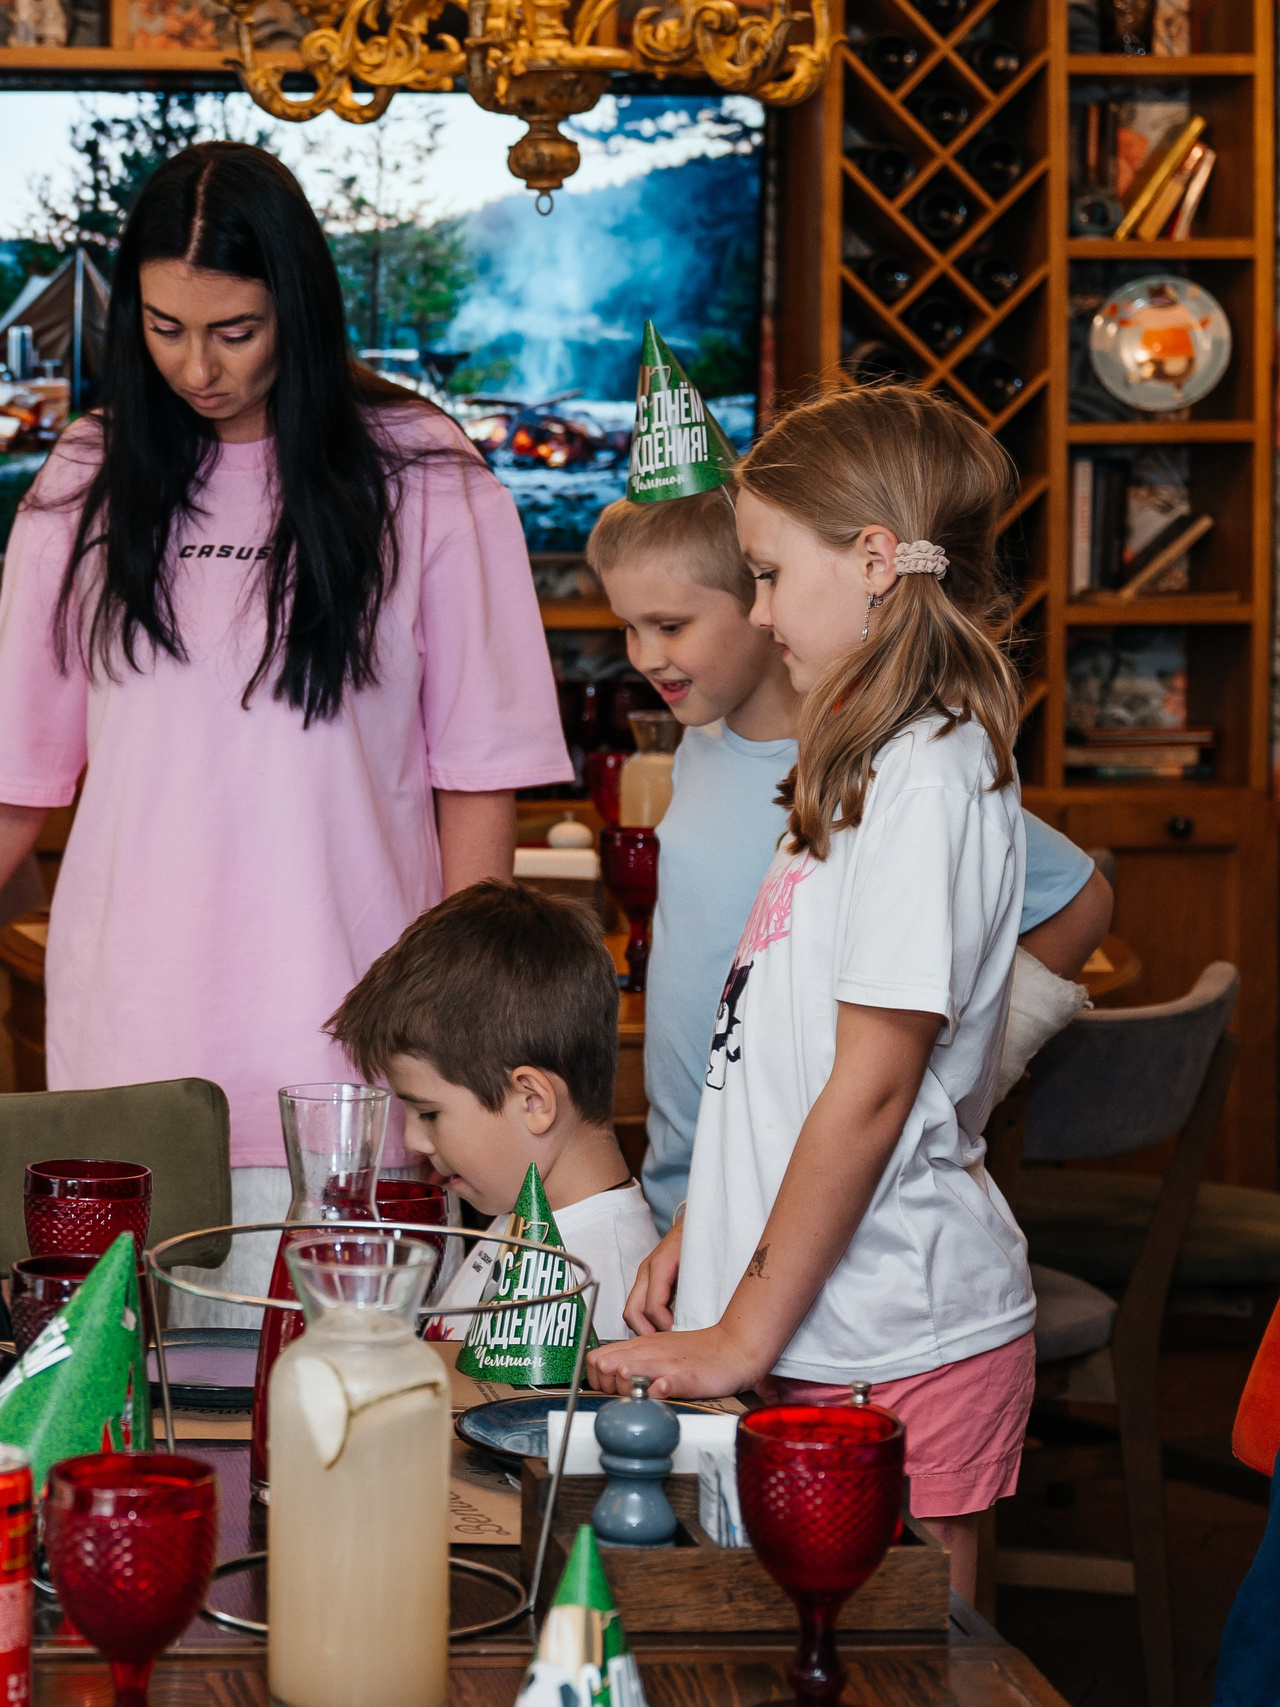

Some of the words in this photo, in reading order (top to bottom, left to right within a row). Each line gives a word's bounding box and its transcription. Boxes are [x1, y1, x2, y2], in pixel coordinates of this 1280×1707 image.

[639, 395, 649, 433] С
[651, 381, 705, 434] ДНЁМ
[499, 1251, 515, 1296] С
[474, 1345, 546, 1369] Чемпион
